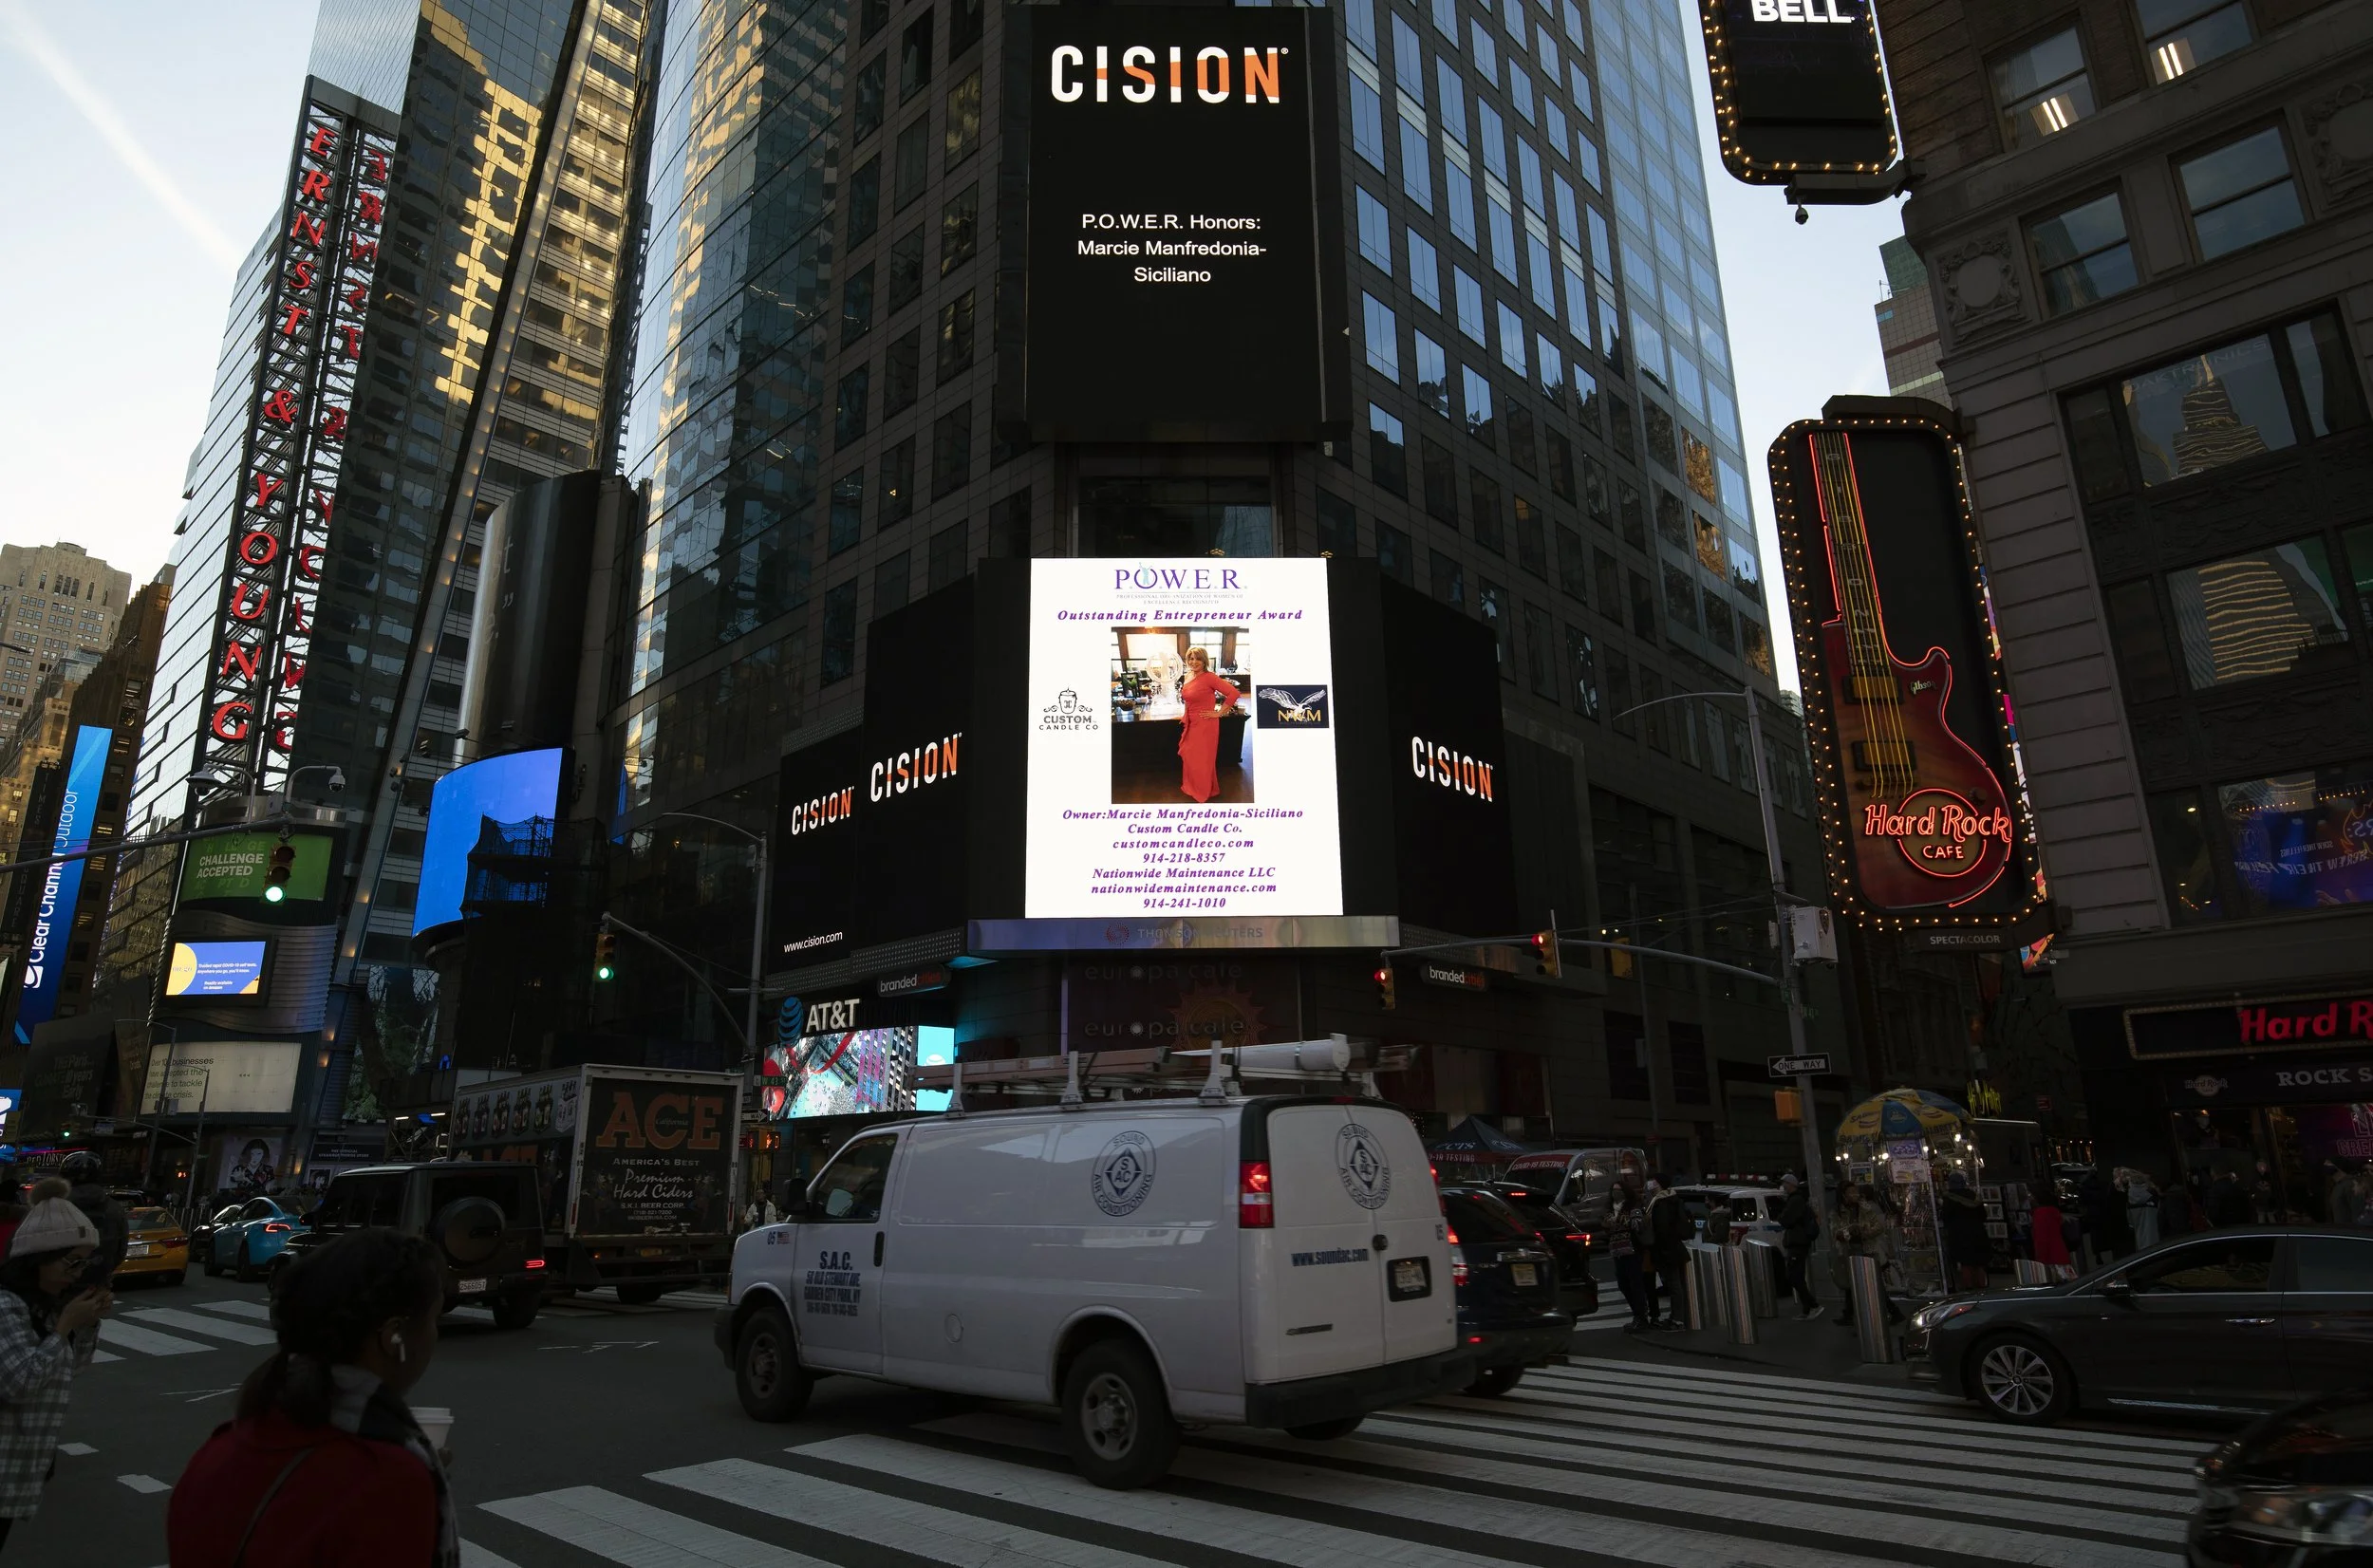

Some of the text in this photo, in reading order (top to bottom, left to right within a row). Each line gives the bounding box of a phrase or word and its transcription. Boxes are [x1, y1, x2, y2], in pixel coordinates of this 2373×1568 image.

[1082, 214, 1261, 230] P.O.W.E.R. Honors:
[1077, 240, 1266, 256] Marcie Manfredonia-
[1133, 267, 1211, 284] Siciliano
[212, 127, 335, 740] ERNST & YOUNG
[1057, 609, 1302, 622] Outstanding Entrepreneur Award
[870, 734, 958, 802] CISION
[1412, 737, 1492, 802] CISION
[792, 787, 852, 835] CISION
[1062, 809, 1303, 821] Owner:Marcie Manfredonia-Siciliano
[1128, 824, 1243, 833] Custom Candle Co.
[1864, 804, 2011, 843] Hard Rock
[1112, 838, 1254, 849] customcandleco.com
[199, 853, 264, 866] CHALLENGE
[1143, 852, 1225, 864] 914-218-8357
[1923, 846, 1964, 859] CAFE
[196, 866, 252, 878] ACCEPTED
[1093, 867, 1276, 879] Nationwide Maintenance LLC
[1091, 882, 1277, 894] nationwidemaintenance.com
[1143, 897, 1226, 908] 914-241-1010
[29, 897, 51, 963] Clear
[783, 931, 843, 953] www.cision.com
[1930, 935, 2001, 945] SPECTACOLOR
[806, 998, 861, 1033] AT&T
[2240, 1001, 2339, 1043] Hard
[1779, 1059, 1822, 1070] ONE WAY
[2276, 1068, 2352, 1086] ROCK
[595, 1092, 724, 1150] ACE
[613, 1157, 700, 1167] AMERICA'S BEST
[1446, 1153, 1475, 1163] TESTING
[625, 1168, 684, 1185] Premium
[613, 1184, 694, 1199] Hard Ciders
[820, 1251, 852, 1270] S.A.C.
[1291, 1248, 1369, 1266] www.soundac.com
